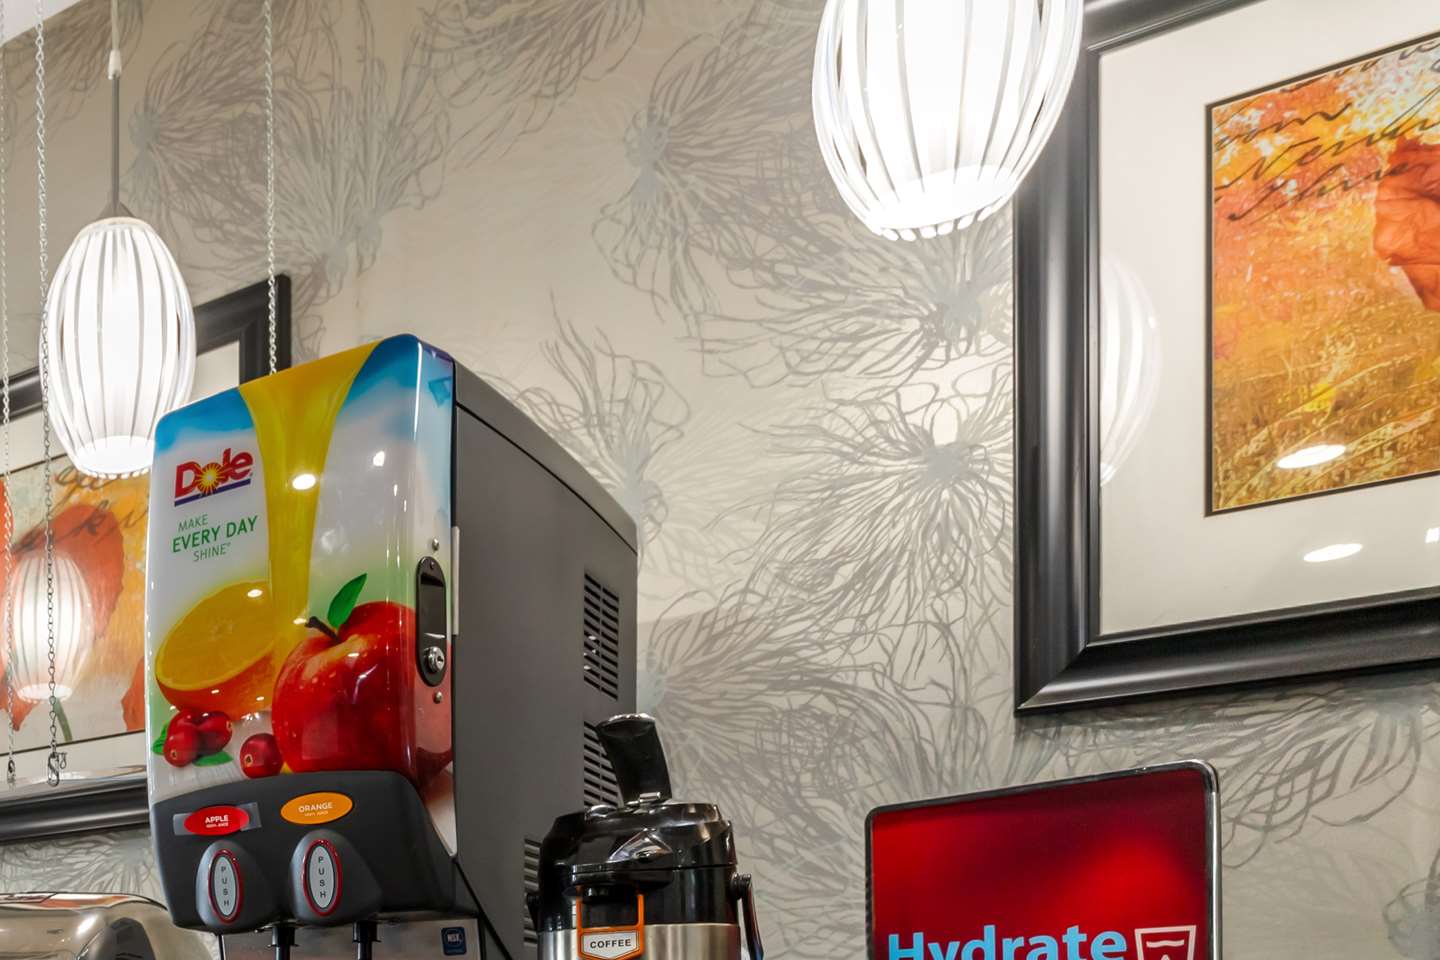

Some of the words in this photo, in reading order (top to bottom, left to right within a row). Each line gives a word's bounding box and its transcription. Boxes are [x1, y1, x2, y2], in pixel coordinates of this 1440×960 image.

[174, 447, 254, 499] Dole
[172, 525, 221, 553] EVERY
[225, 515, 258, 539] DAY
[177, 514, 209, 532] MAKE
[204, 814, 229, 824] APPLE
[297, 802, 334, 814] ORANGE
[220, 866, 230, 907] PUSH
[317, 856, 327, 898] PUSH
[589, 938, 632, 949] COFFEE
